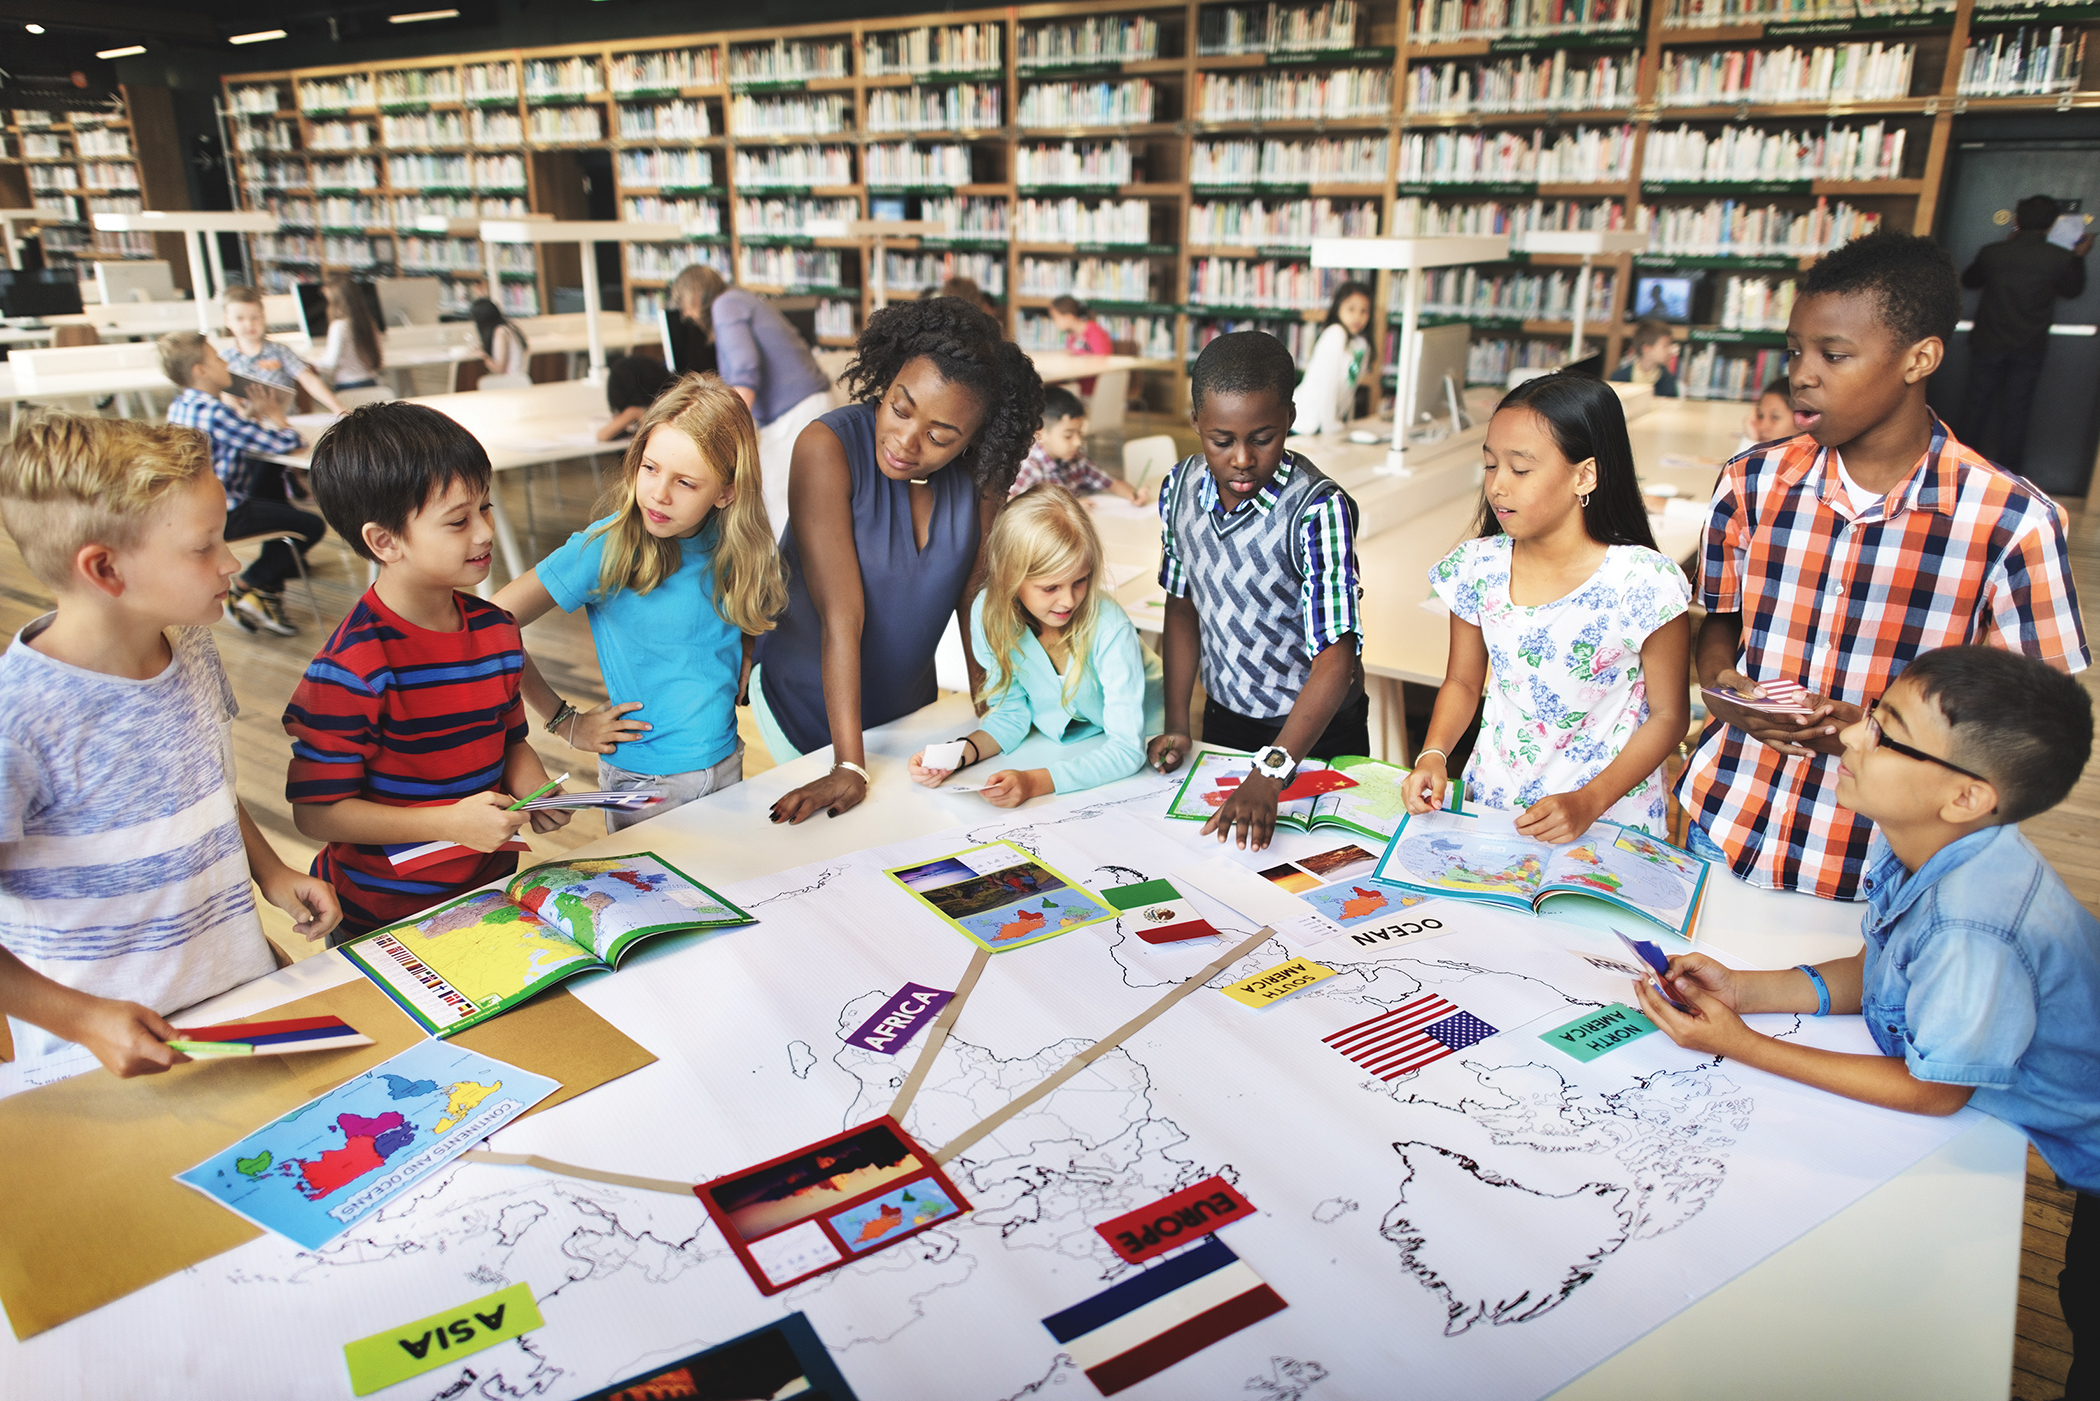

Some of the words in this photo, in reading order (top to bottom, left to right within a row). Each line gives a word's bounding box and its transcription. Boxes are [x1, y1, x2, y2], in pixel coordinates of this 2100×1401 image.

[1351, 918, 1443, 946] OCEAN
[1240, 963, 1307, 994] AMERICA
[1261, 975, 1317, 999] SOUTH
[863, 992, 940, 1051] AFRICA
[1558, 1010, 1627, 1042] AMERICA
[1586, 1024, 1643, 1052] NORTH
[433, 1103, 512, 1155] CONTINENTS
[403, 1155, 432, 1177] AND
[341, 1174, 402, 1215] OCEANS
[1115, 1191, 1238, 1254] EUROPE
[398, 1303, 505, 1359] ASIA
